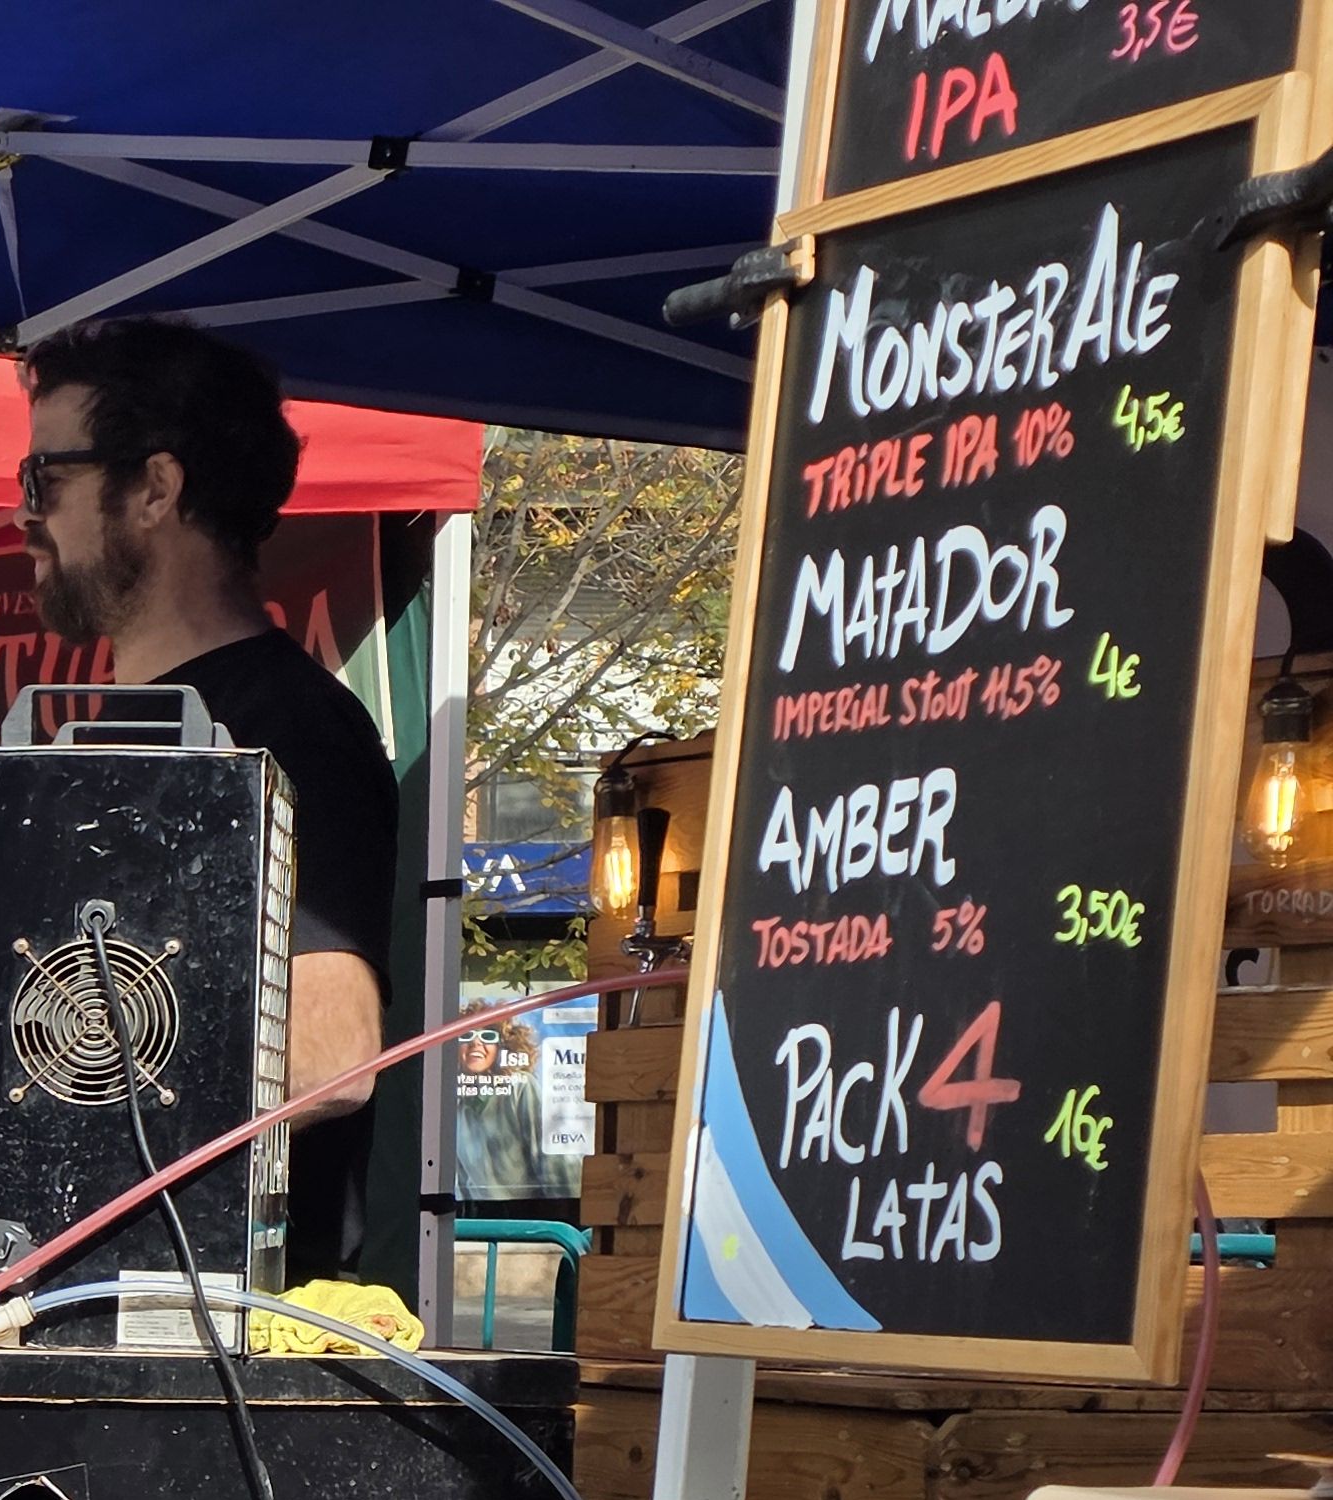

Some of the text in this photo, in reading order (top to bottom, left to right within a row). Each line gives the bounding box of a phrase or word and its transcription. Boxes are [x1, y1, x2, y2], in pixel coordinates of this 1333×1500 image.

[906, 52, 1018, 160] IPA
[941, 414, 1000, 489] IPA
[1013, 401, 1075, 467] 10%
[1112, 384, 1186, 452] 4,5€
[1088, 631, 1141, 699] 4€
[758, 767, 958, 894] AMBER
[751, 884, 1146, 969] TOSTADA 5% 3,50€
[500, 1049, 530, 1067] Isa
[775, 1001, 1022, 1170] PACK 4
[1044, 1084, 1115, 1172] 16€
